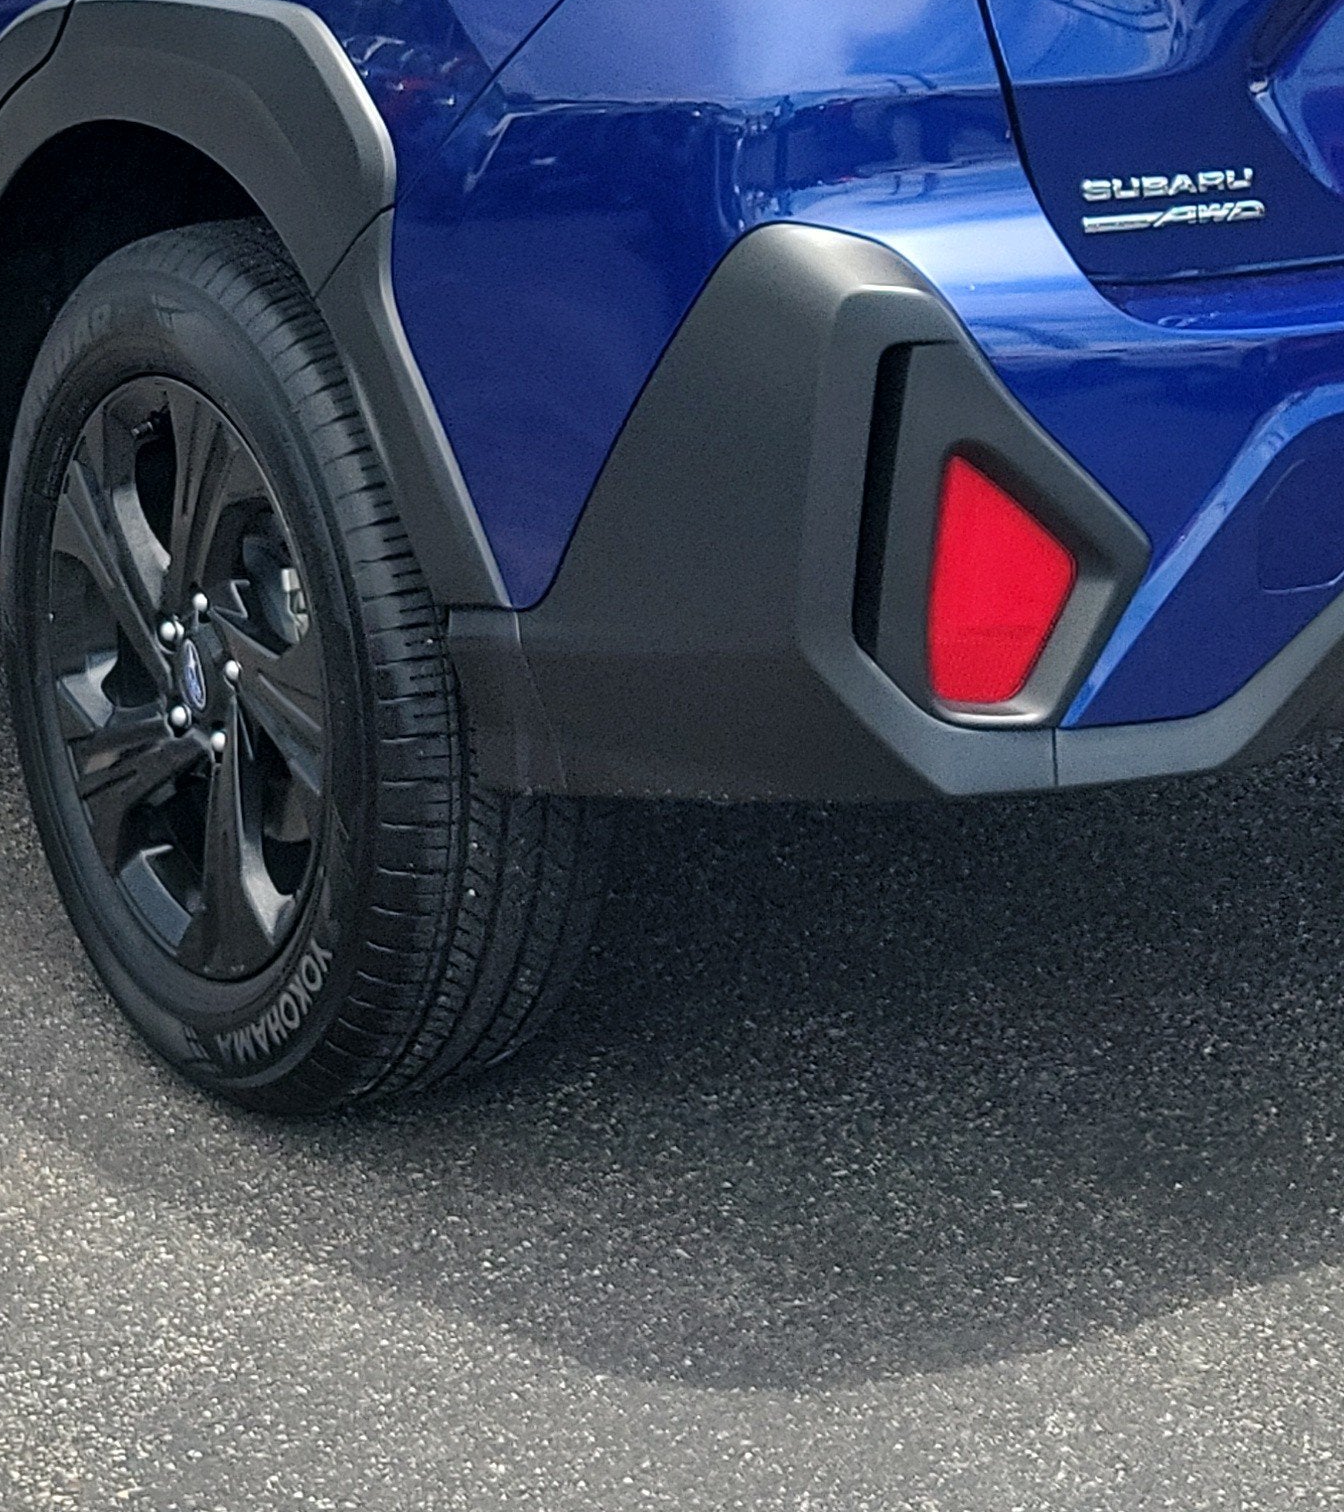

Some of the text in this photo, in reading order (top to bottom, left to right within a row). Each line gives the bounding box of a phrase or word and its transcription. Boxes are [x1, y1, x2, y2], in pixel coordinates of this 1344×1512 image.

[1081, 167, 1254, 202] SUBARU
[1153, 199, 1266, 228] AWD
[215, 937, 334, 1065] YOKOHAMA
